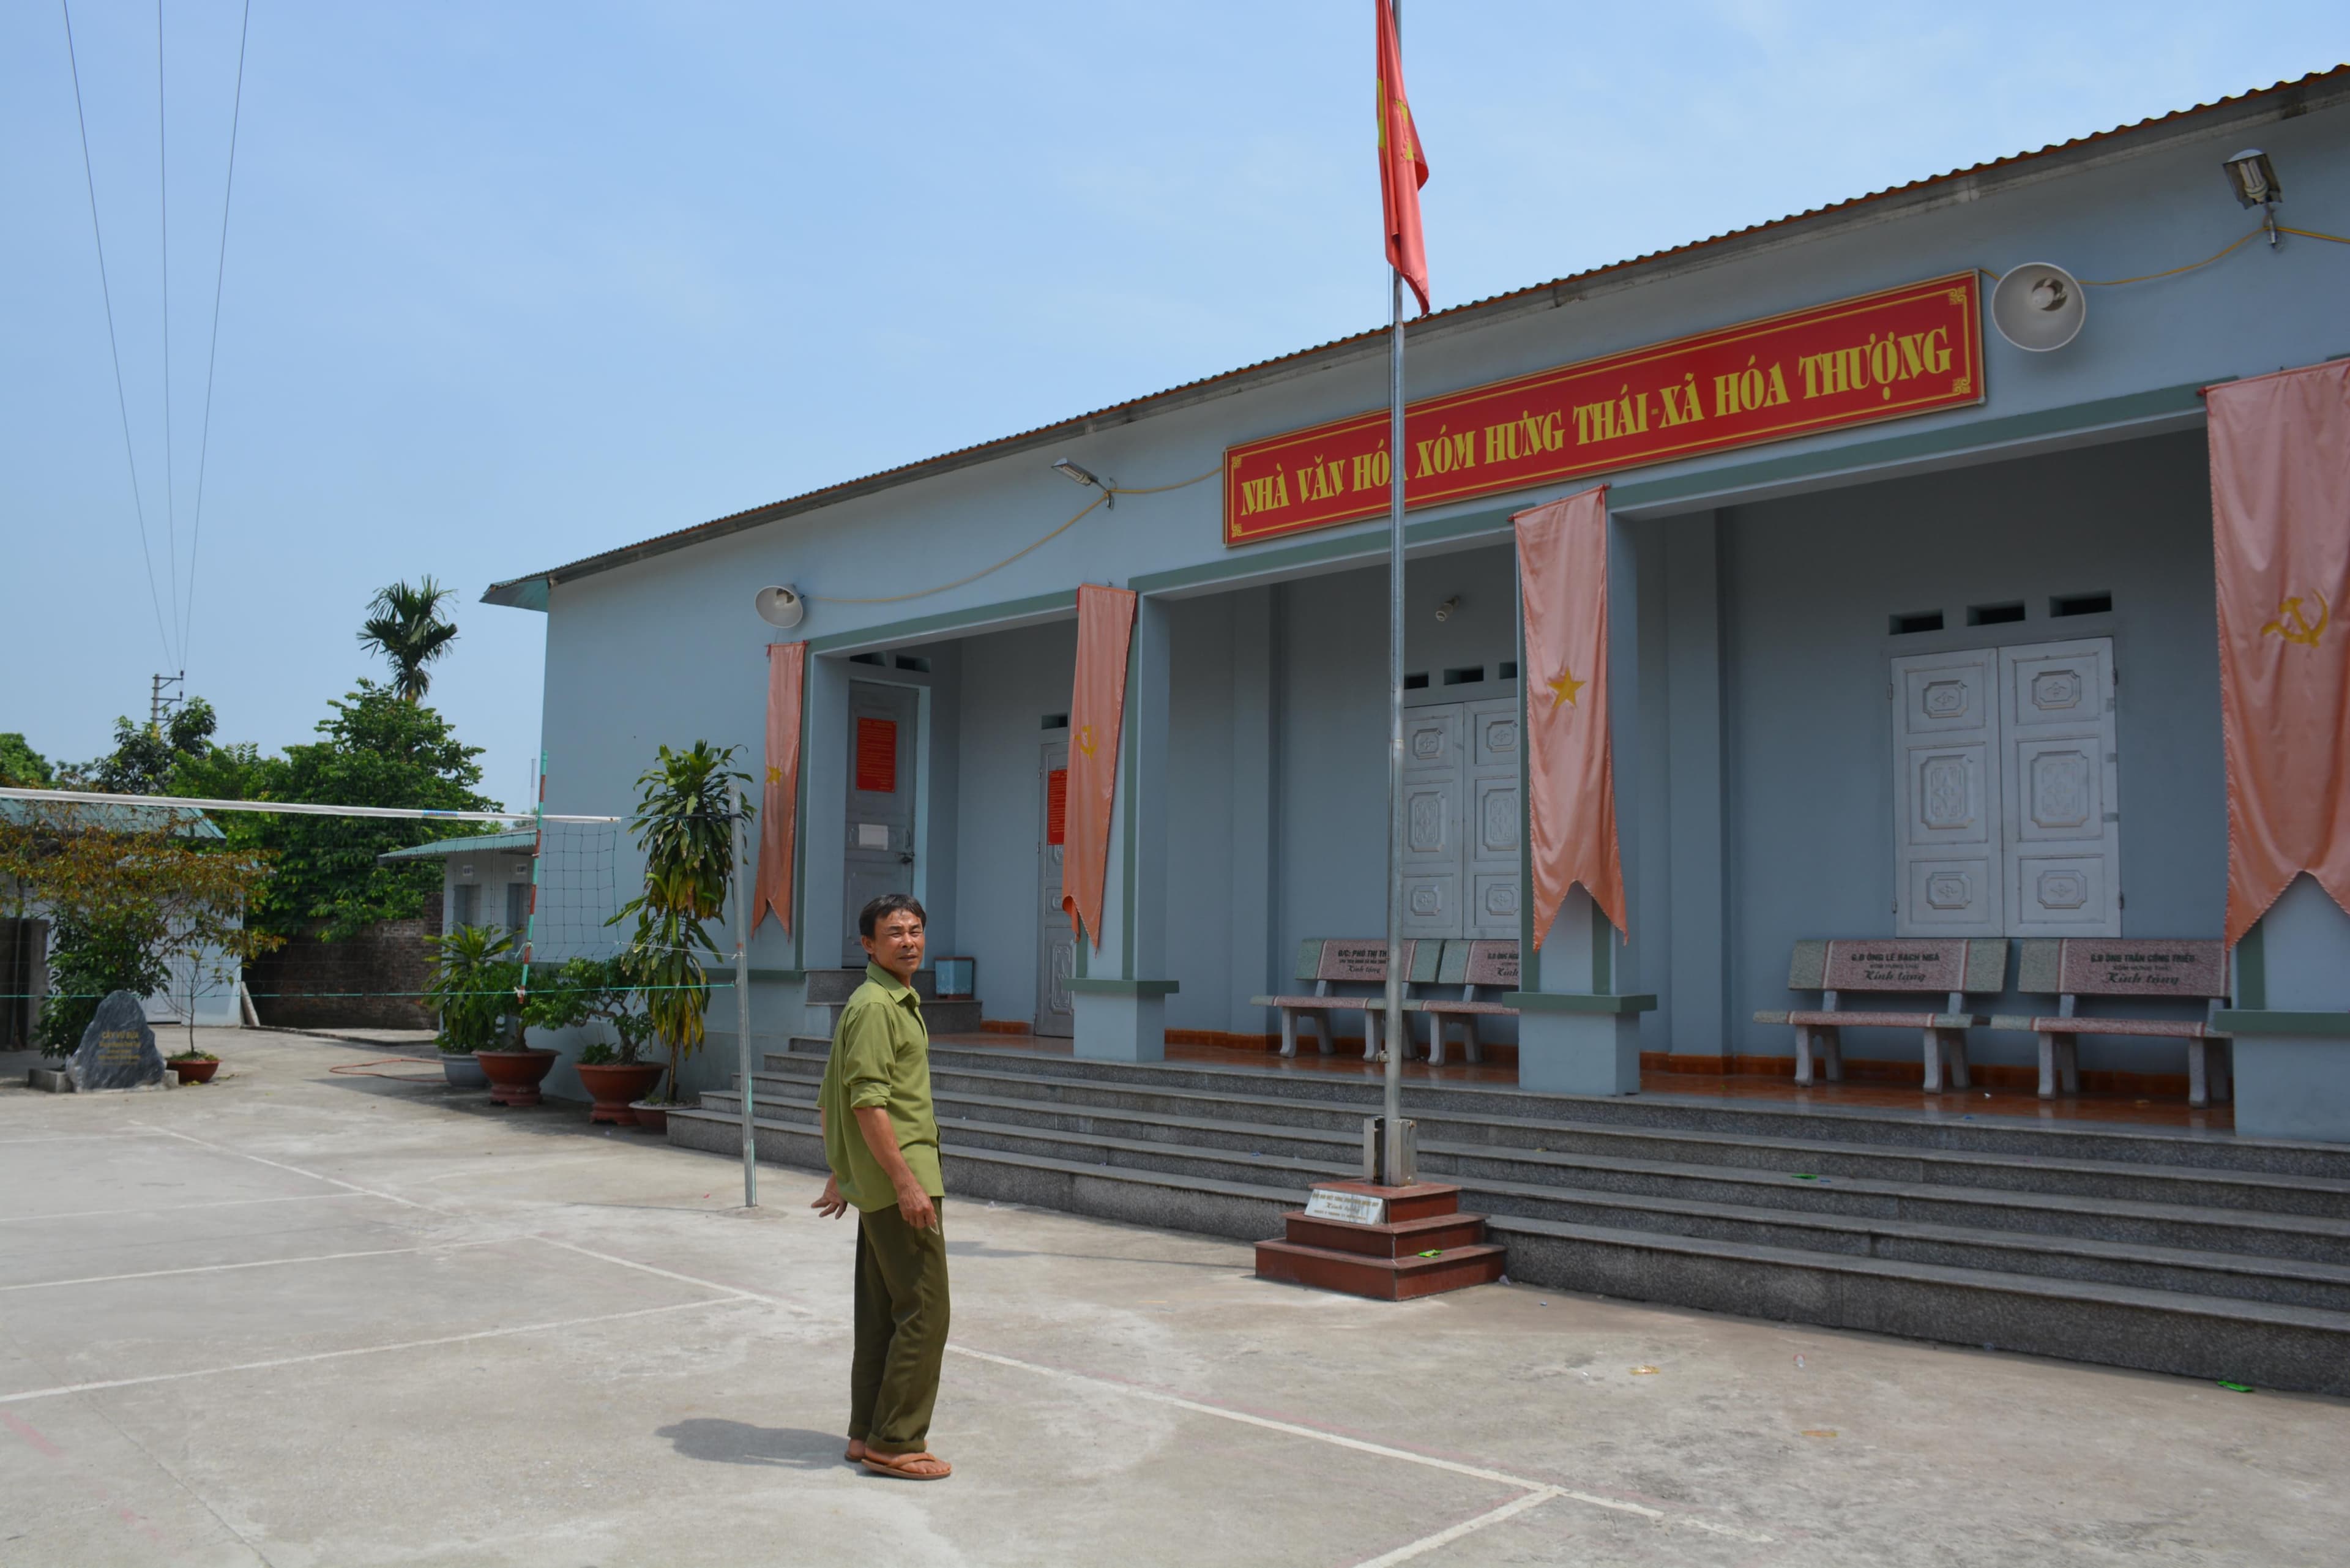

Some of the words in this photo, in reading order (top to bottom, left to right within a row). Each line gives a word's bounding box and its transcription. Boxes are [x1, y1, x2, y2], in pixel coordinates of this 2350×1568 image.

[1240, 463, 1290, 515] NHÀ
[1296, 454, 1346, 504] VĂN
[1416, 424, 1475, 479] XÓM
[1484, 410, 1565, 464] HƯNG
[1714, 355, 1790, 417] HÓA
[1798, 325, 1953, 400] THƯỢNG
[1864, 970, 1894, 980] Kính
